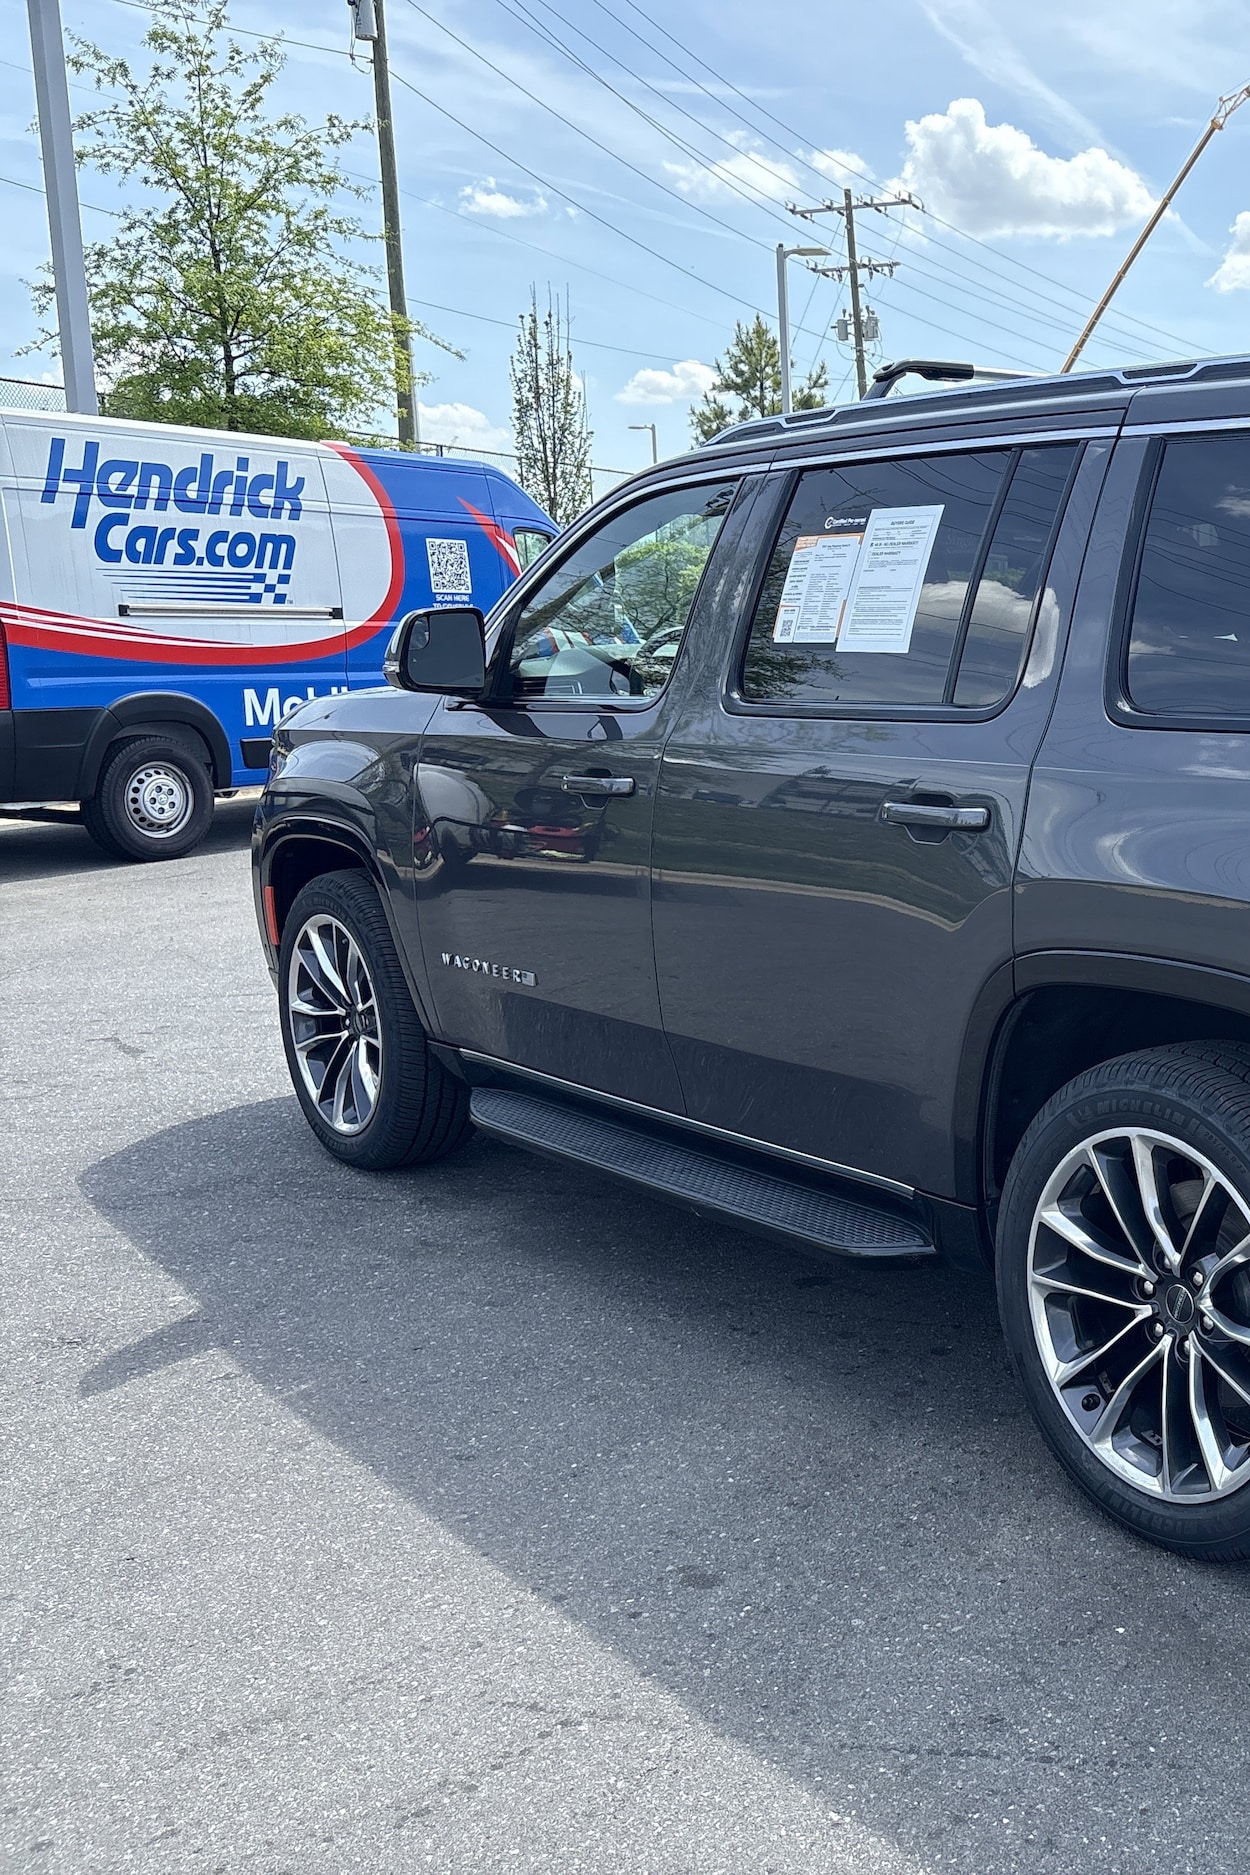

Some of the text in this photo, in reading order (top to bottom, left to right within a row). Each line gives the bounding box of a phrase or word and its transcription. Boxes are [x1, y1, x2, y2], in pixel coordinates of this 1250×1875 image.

[40, 437, 306, 529] Hendrick
[94, 512, 297, 570] Cars.com
[453, 594, 470, 602] HERE
[441, 952, 521, 983] WAGONEER
[1097, 1098, 1186, 1127] MICHELIN
